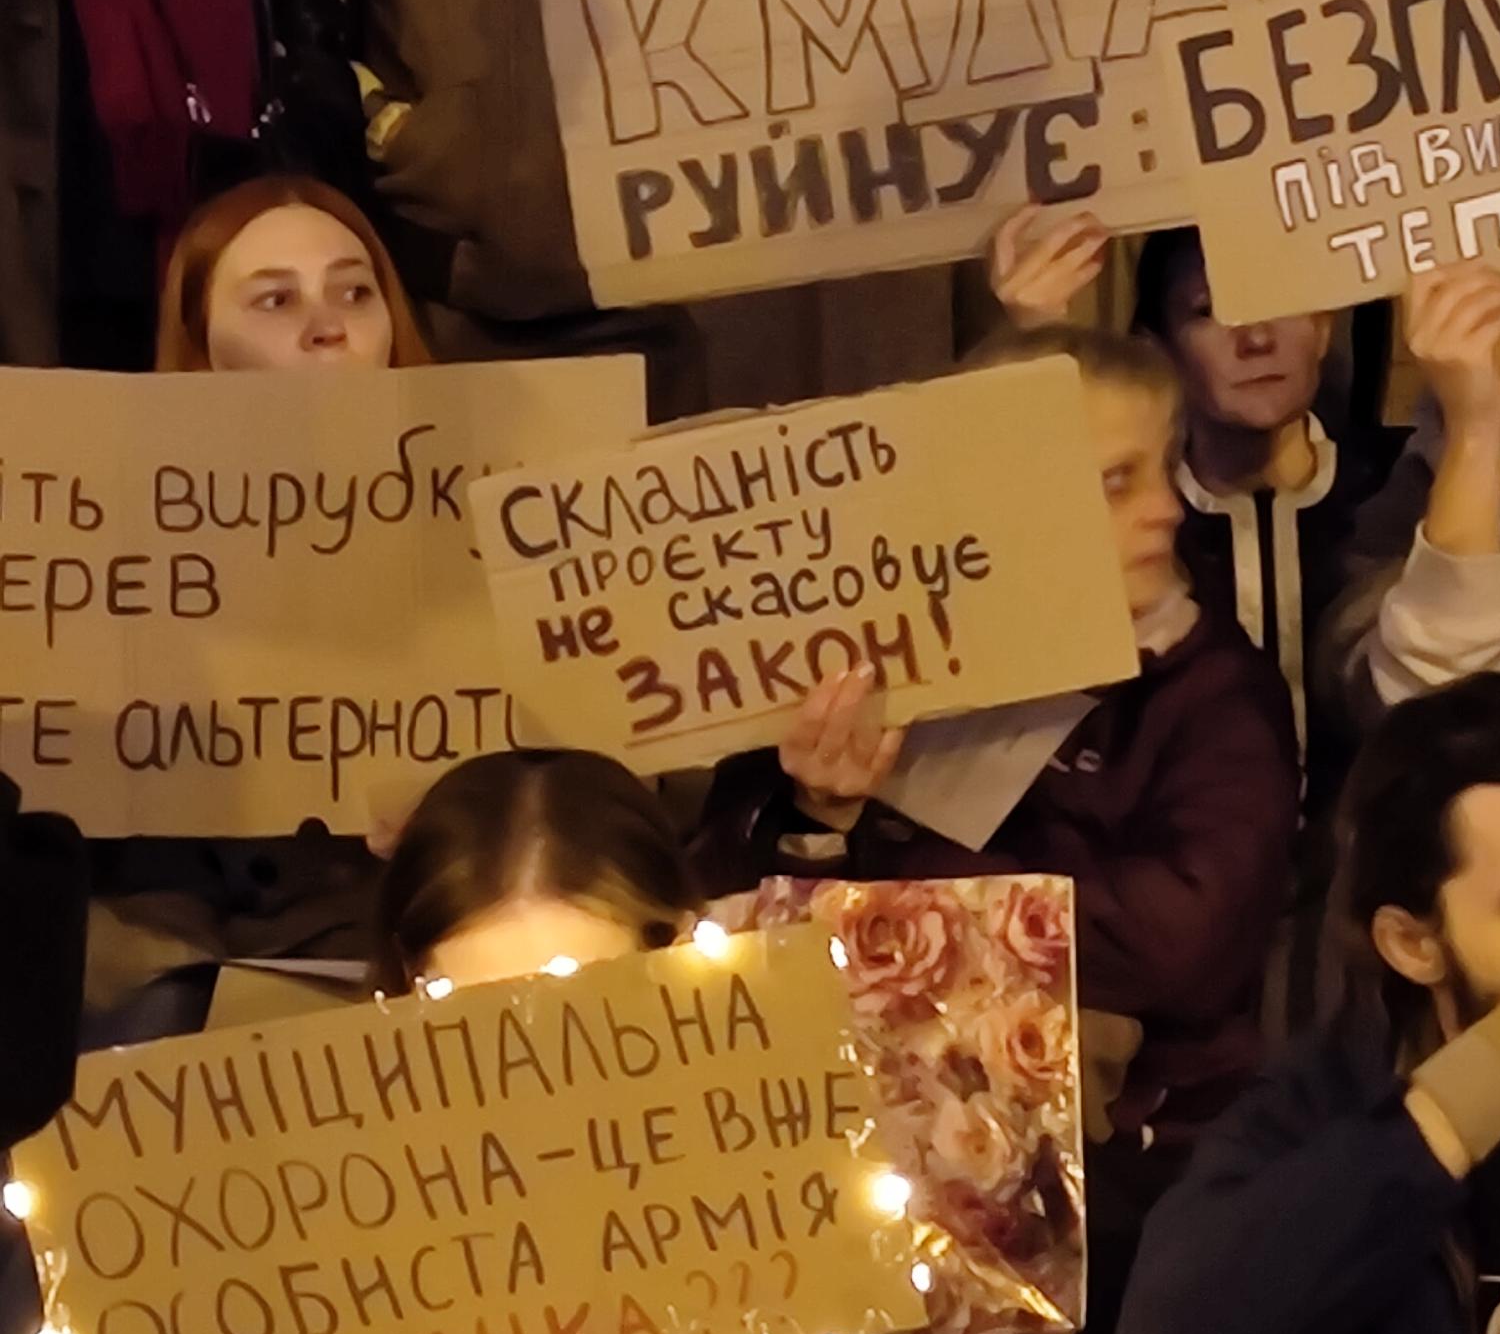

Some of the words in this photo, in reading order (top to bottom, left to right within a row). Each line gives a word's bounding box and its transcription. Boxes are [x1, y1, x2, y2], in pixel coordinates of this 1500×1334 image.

[1271, 142, 1402, 231] ПІД
[0, 553, 222, 648] ЕРЕВ
[536, 606, 620, 662] не
[617, 593, 961, 733] ЗАКОН!
[56, 973, 773, 1172] МУНІЦИПАЛЬНА
[703, 1067, 868, 1157] ВЖЕ
[601, 1169, 838, 1275] АРМІЯ
